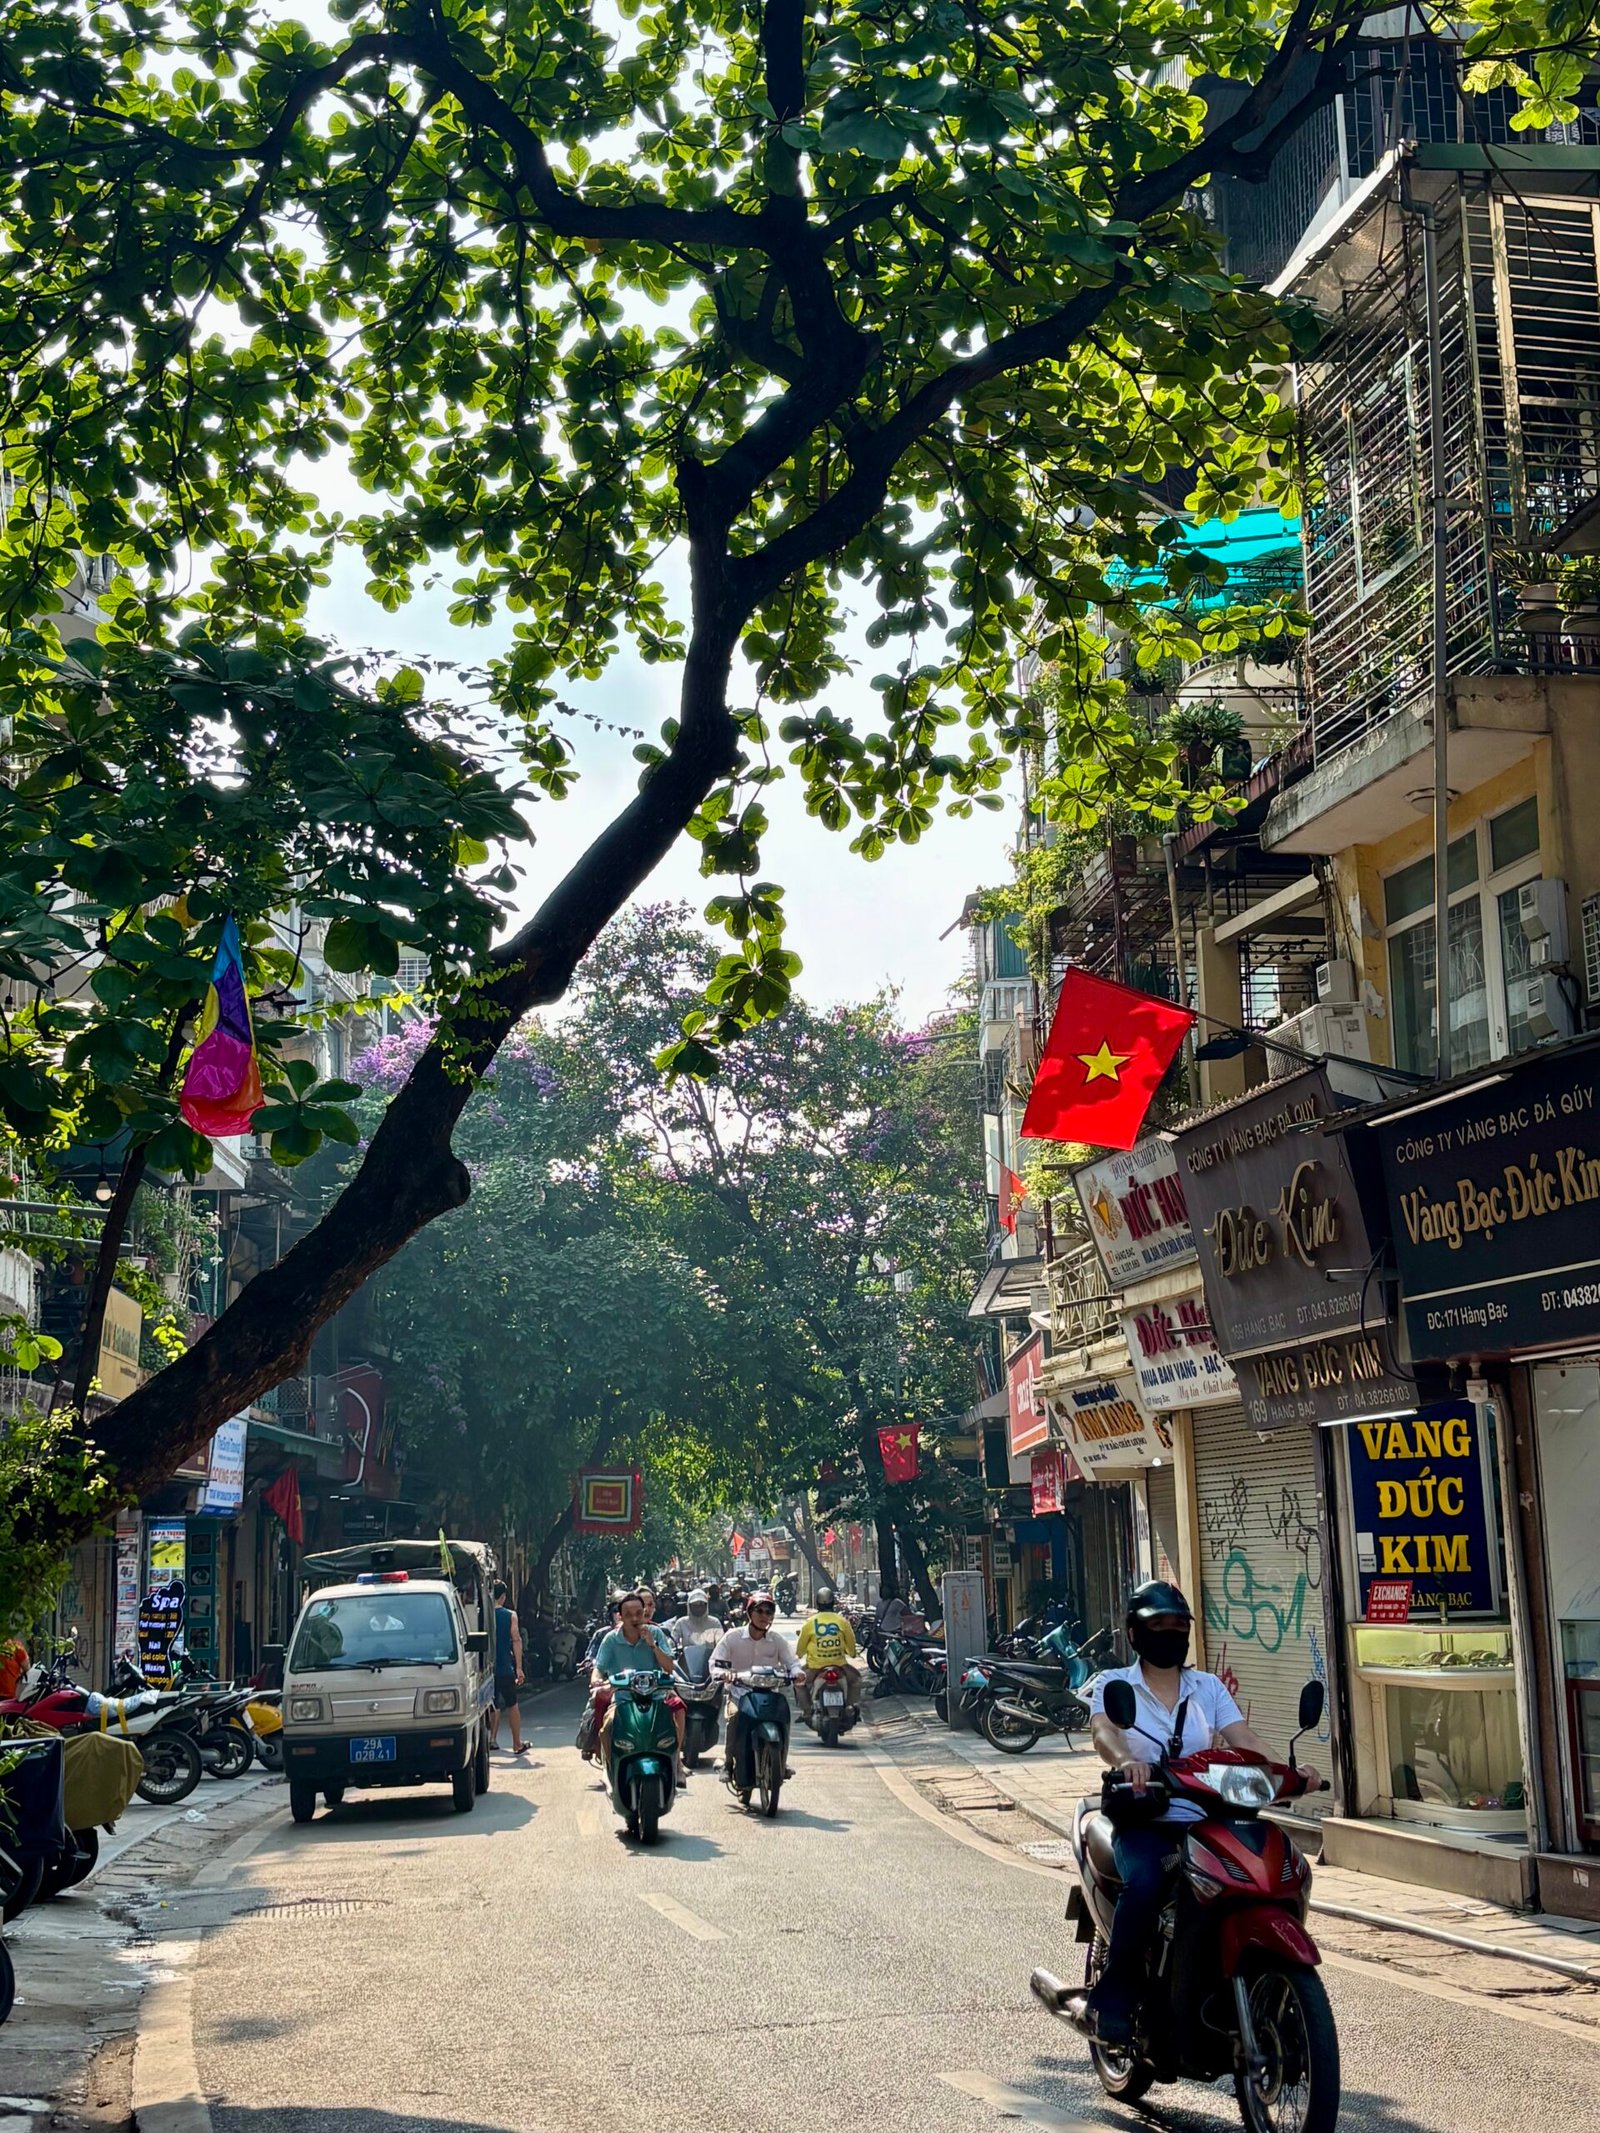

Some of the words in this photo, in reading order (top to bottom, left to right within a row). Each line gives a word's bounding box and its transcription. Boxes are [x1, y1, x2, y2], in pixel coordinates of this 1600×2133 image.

[1213, 1140, 1226, 1162] TY
[1227, 1128, 1254, 1156] VÀNG
[1256, 1117, 1277, 1147] BẠC
[1396, 1137, 1434, 1164] CÔNG
[1437, 1131, 1452, 1152] TY
[1456, 1119, 1497, 1146] VÀNG
[1499, 1107, 1529, 1136] BẠC
[1533, 1093, 1556, 1123] ĐÁ
[1269, 1159, 1339, 1268] Kim
[1401, 1186, 1463, 1250] Vàng
[1456, 1178, 1507, 1241] Bạc
[1503, 1153, 1561, 1220] Đức
[1460, 1305, 1487, 1328] Hàng
[1487, 1302, 1508, 1323] Bạc
[1541, 1291, 1561, 1311] ĐT:
[1563, 1283, 1600, 1309] 04382
[1141, 1367, 1160, 1389] MUA
[1253, 1352, 1300, 1398] VÀNG
[1302, 1340, 1343, 1390] ĐỨC
[1345, 1338, 1384, 1382] KIM
[1250, 1400, 1268, 1424] 169
[1271, 1402, 1295, 1420] HÀNG
[1299, 1401, 1316, 1421] BẠC
[1354, 1385, 1411, 1409] 04.38266103
[1376, 1466, 1464, 1518] ĐỨC
[1379, 1534, 1471, 1573] KIM
[152, 1594, 180, 1611] Spa
[1373, 1585, 1408, 1601] EXCHANGE
[1449, 1592, 1472, 1609] BẠC
[814, 1618, 839, 1637] be
[355, 1749, 391, 1761] 028.41
[363, 1740, 383, 1750] 29A
